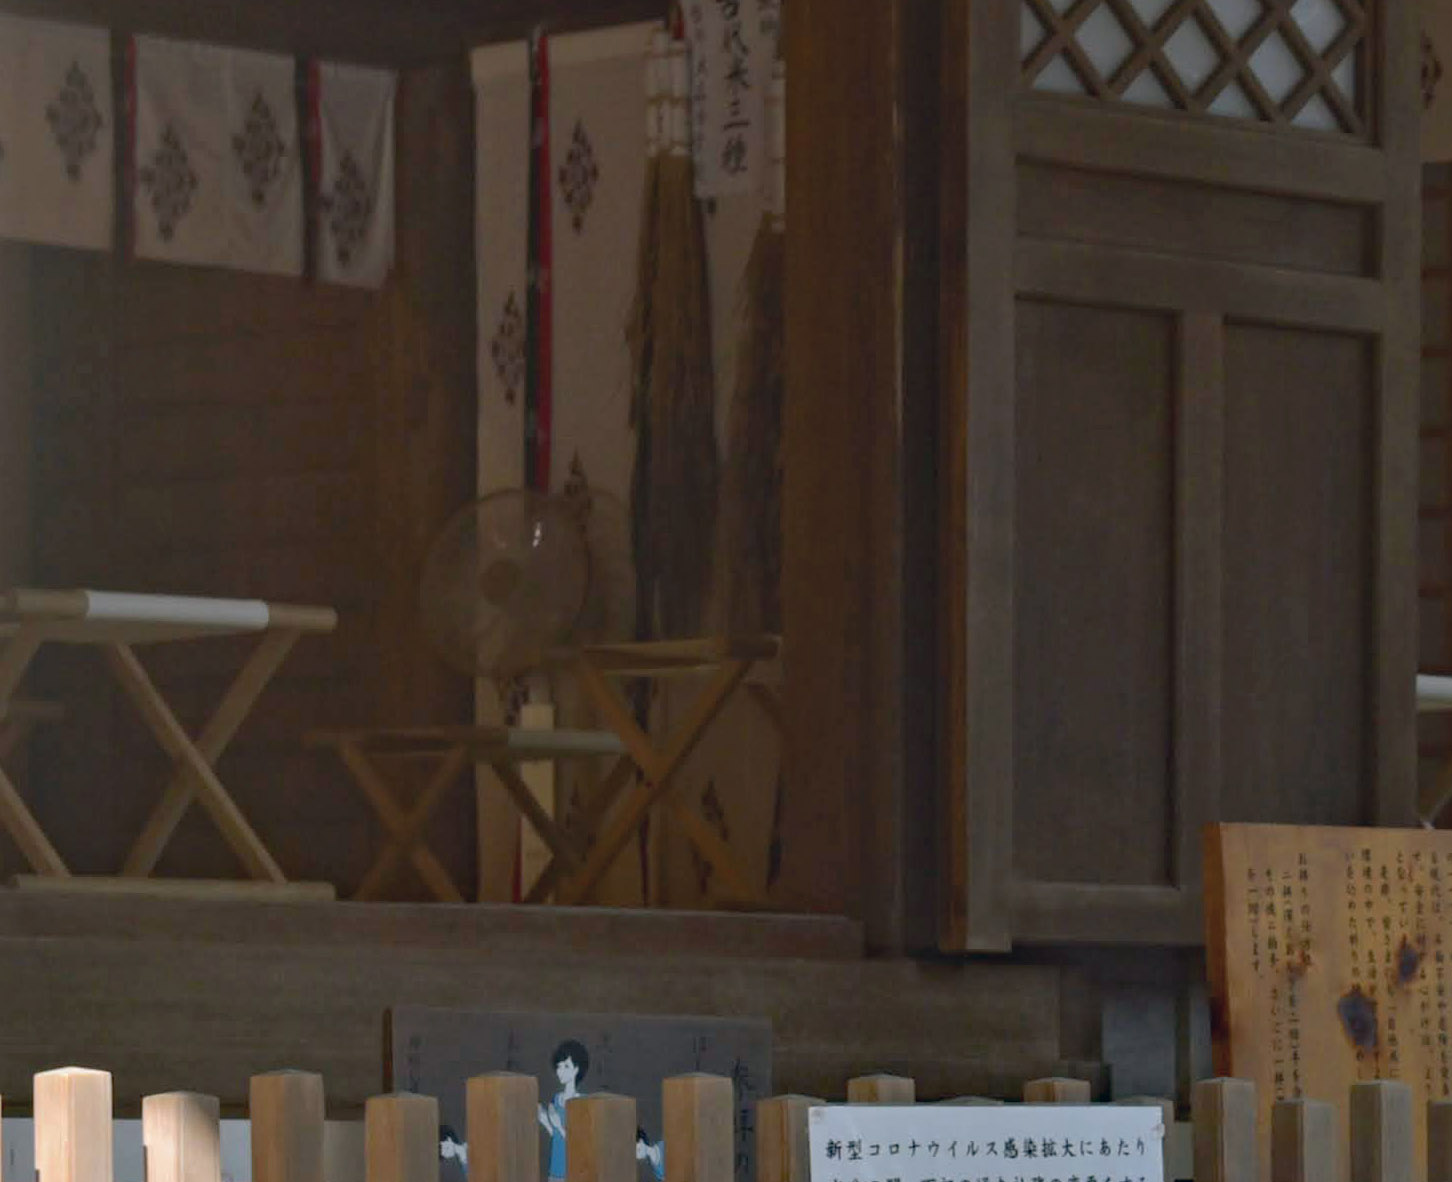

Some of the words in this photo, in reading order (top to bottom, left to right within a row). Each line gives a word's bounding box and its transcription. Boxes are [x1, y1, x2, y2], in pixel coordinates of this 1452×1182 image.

[825, 1137, 1147, 1161] 新型コロナウイルス感染拡大にあたり
